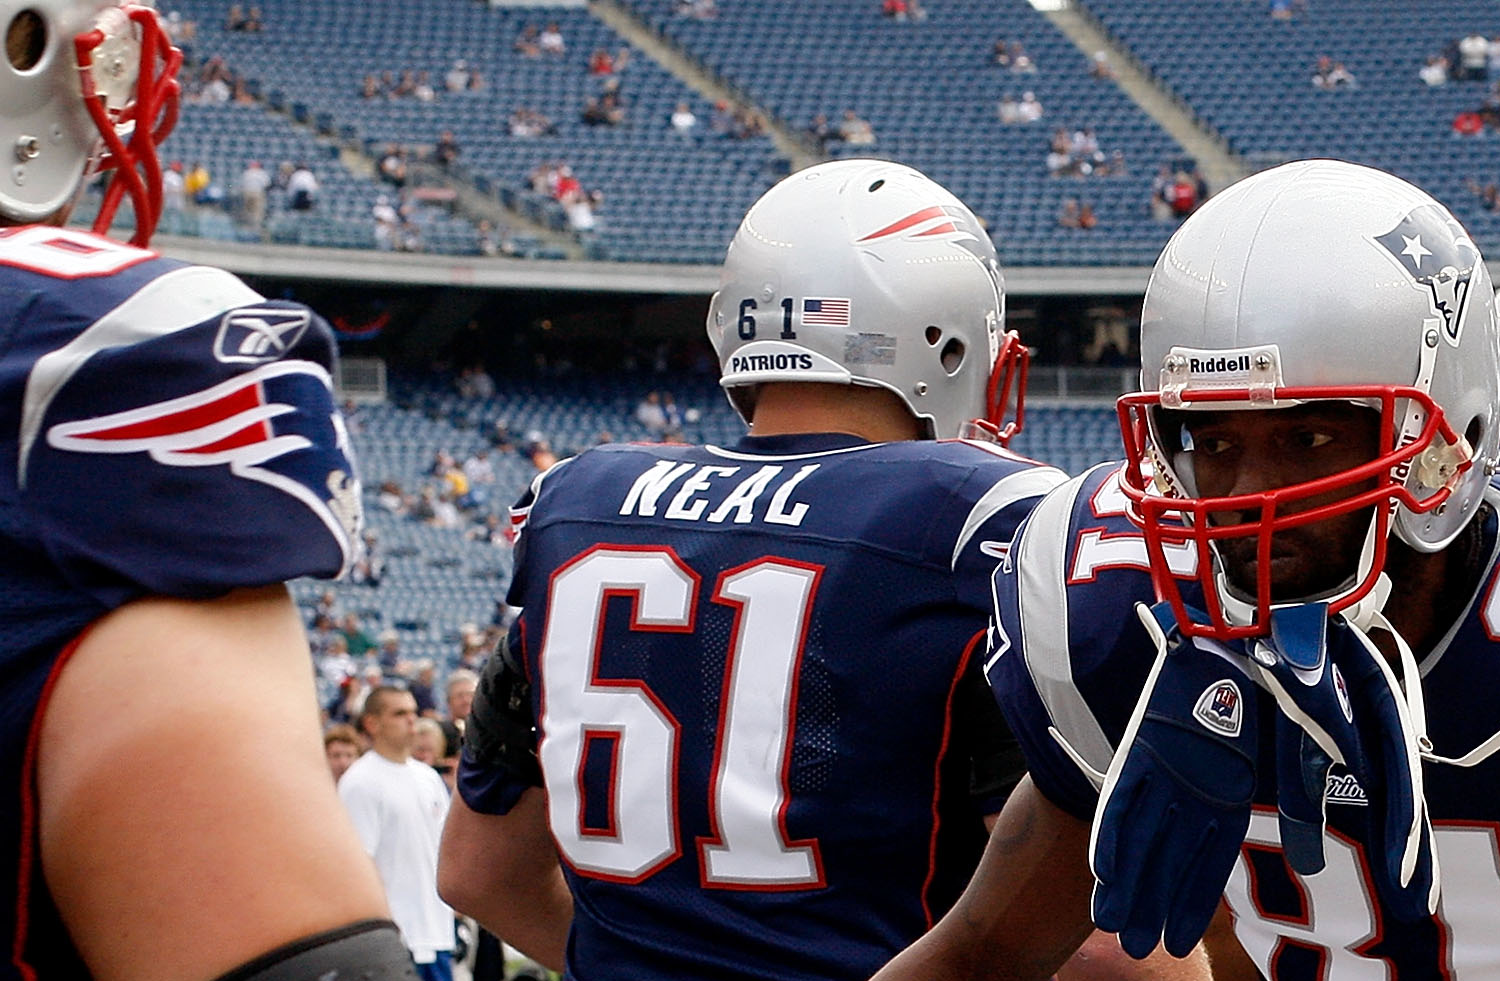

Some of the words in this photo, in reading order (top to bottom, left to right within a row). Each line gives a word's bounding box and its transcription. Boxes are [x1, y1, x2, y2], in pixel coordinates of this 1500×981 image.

[732, 354, 813, 372] PATRIOTS
[1190, 355, 1250, 373] Riddell
[619, 460, 821, 527] NEAL
[538, 543, 827, 889] 61
